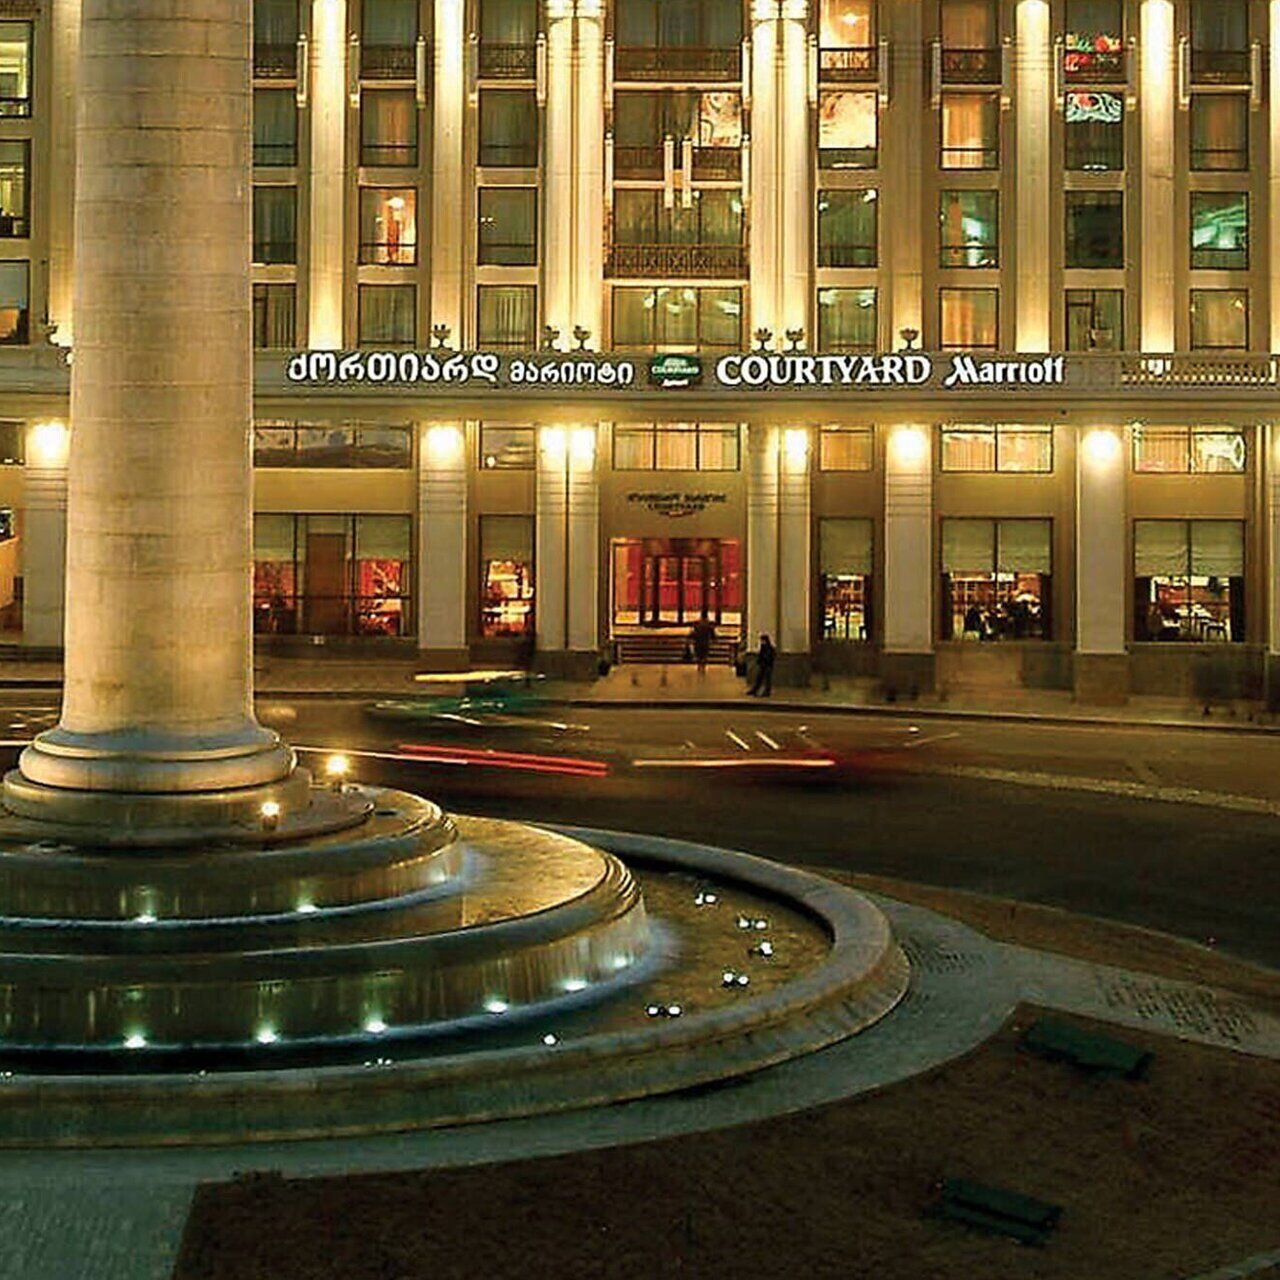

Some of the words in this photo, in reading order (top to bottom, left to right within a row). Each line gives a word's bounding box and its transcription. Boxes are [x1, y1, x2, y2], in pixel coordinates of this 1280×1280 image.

[288, 352, 499, 382] ქორთიარდ
[510, 360, 634, 385] მარიოტი
[716, 355, 932, 385] COURTYARD
[944, 355, 1065, 387] Marriott
